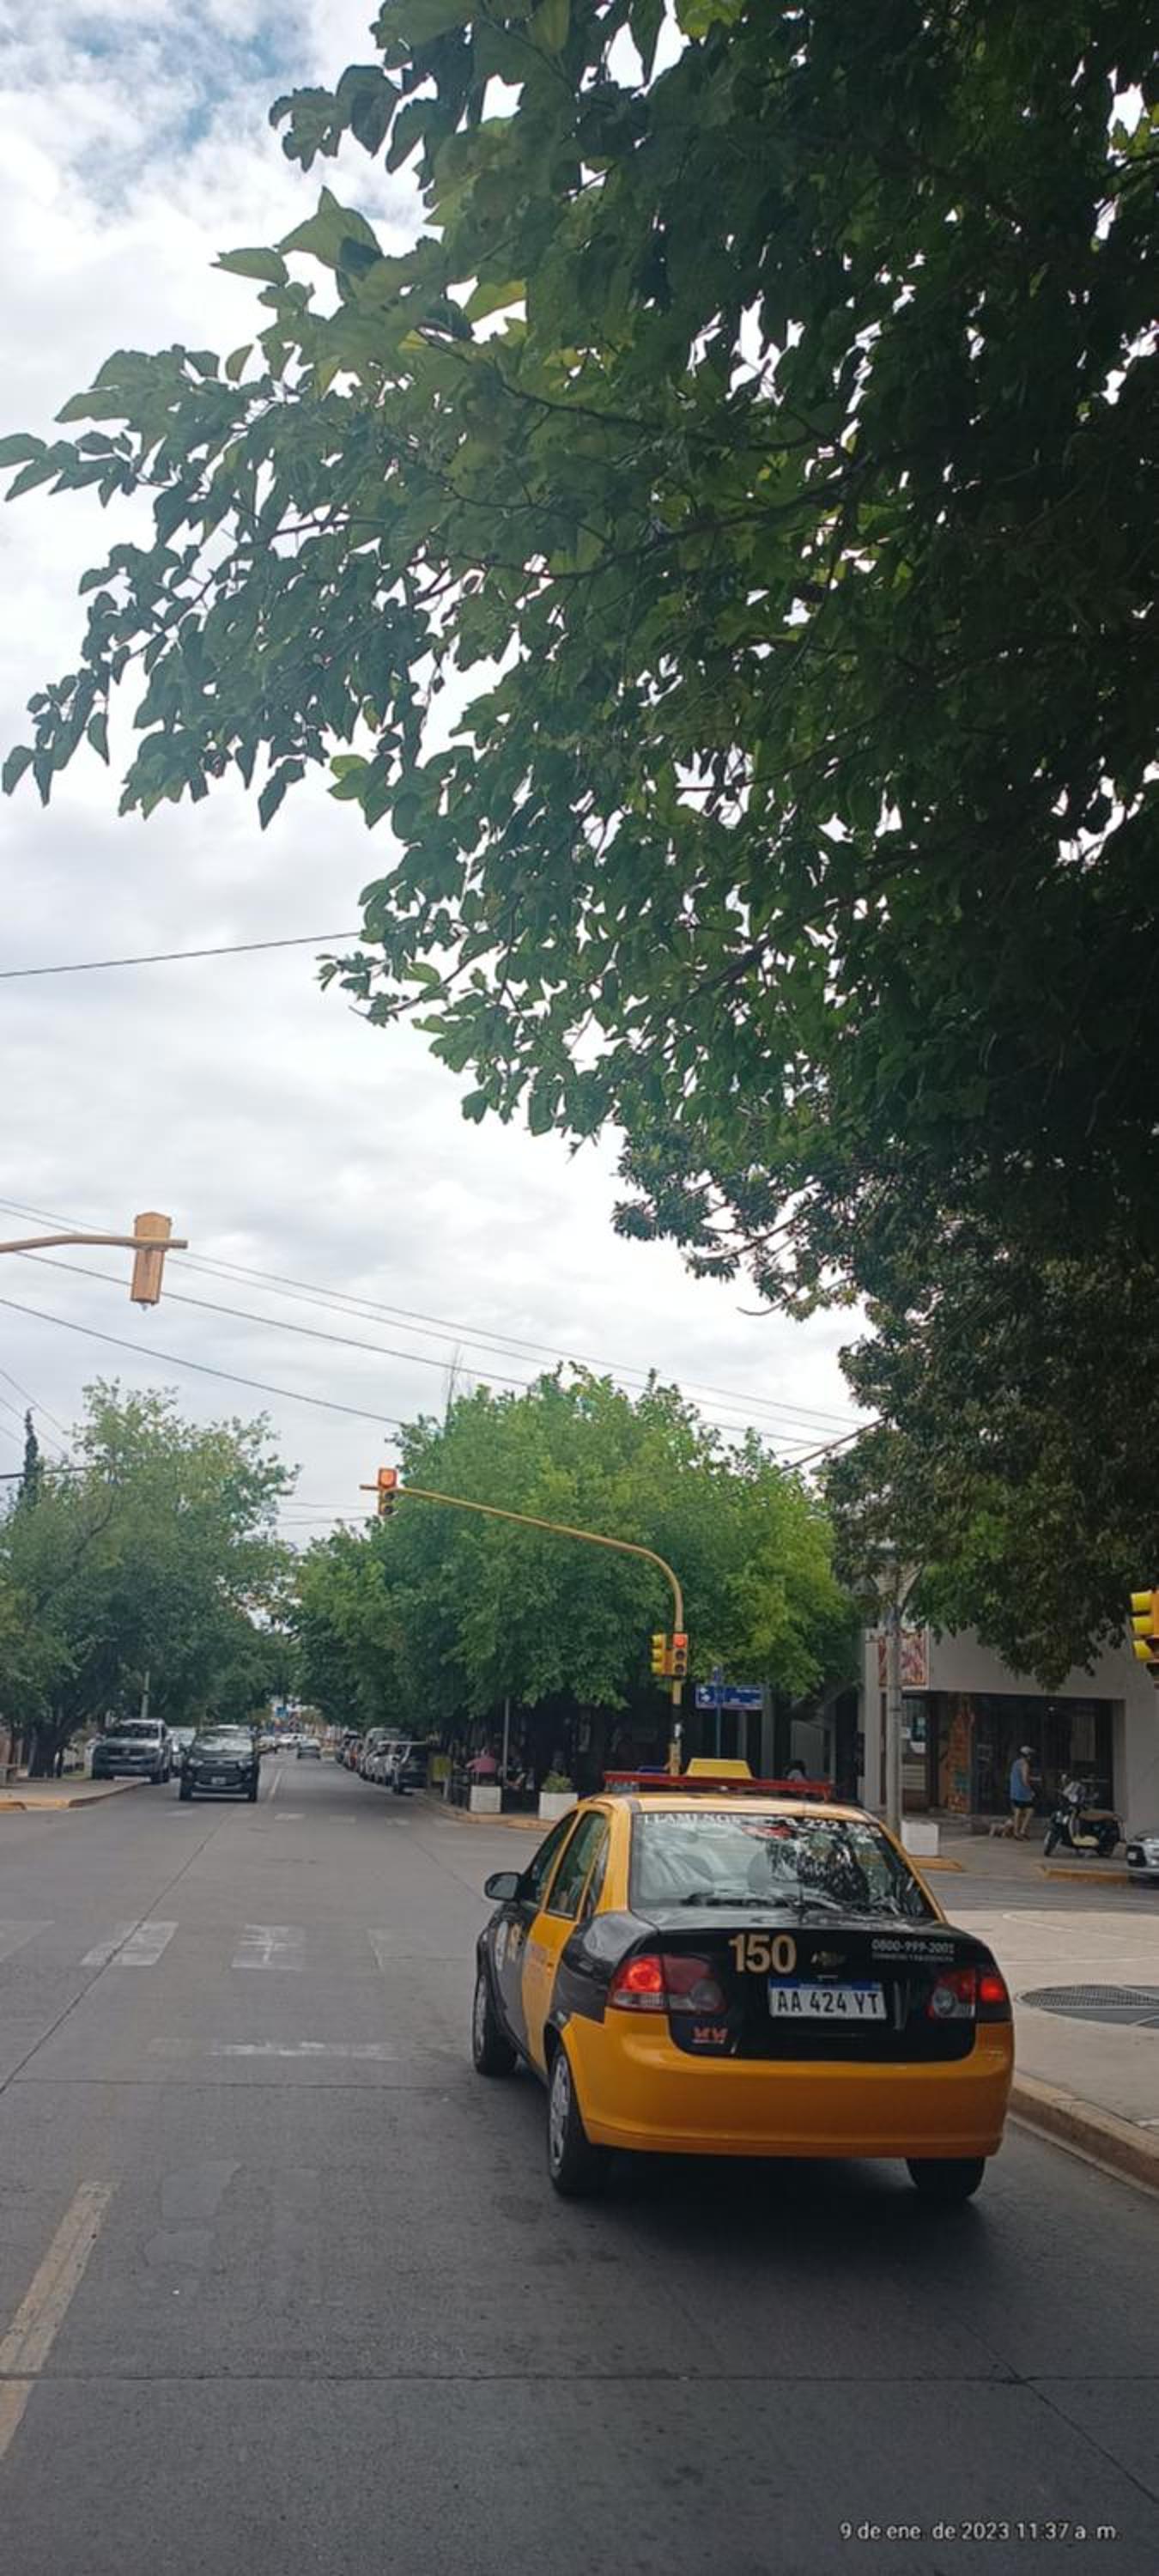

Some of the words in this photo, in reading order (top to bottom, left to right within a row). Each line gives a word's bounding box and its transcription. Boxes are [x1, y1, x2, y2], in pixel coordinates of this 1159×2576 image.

[729, 1934, 797, 1973] 150
[777, 1991, 802, 2013] AA
[810, 1991, 846, 2014] 424
[853, 1992, 878, 2014] YT
